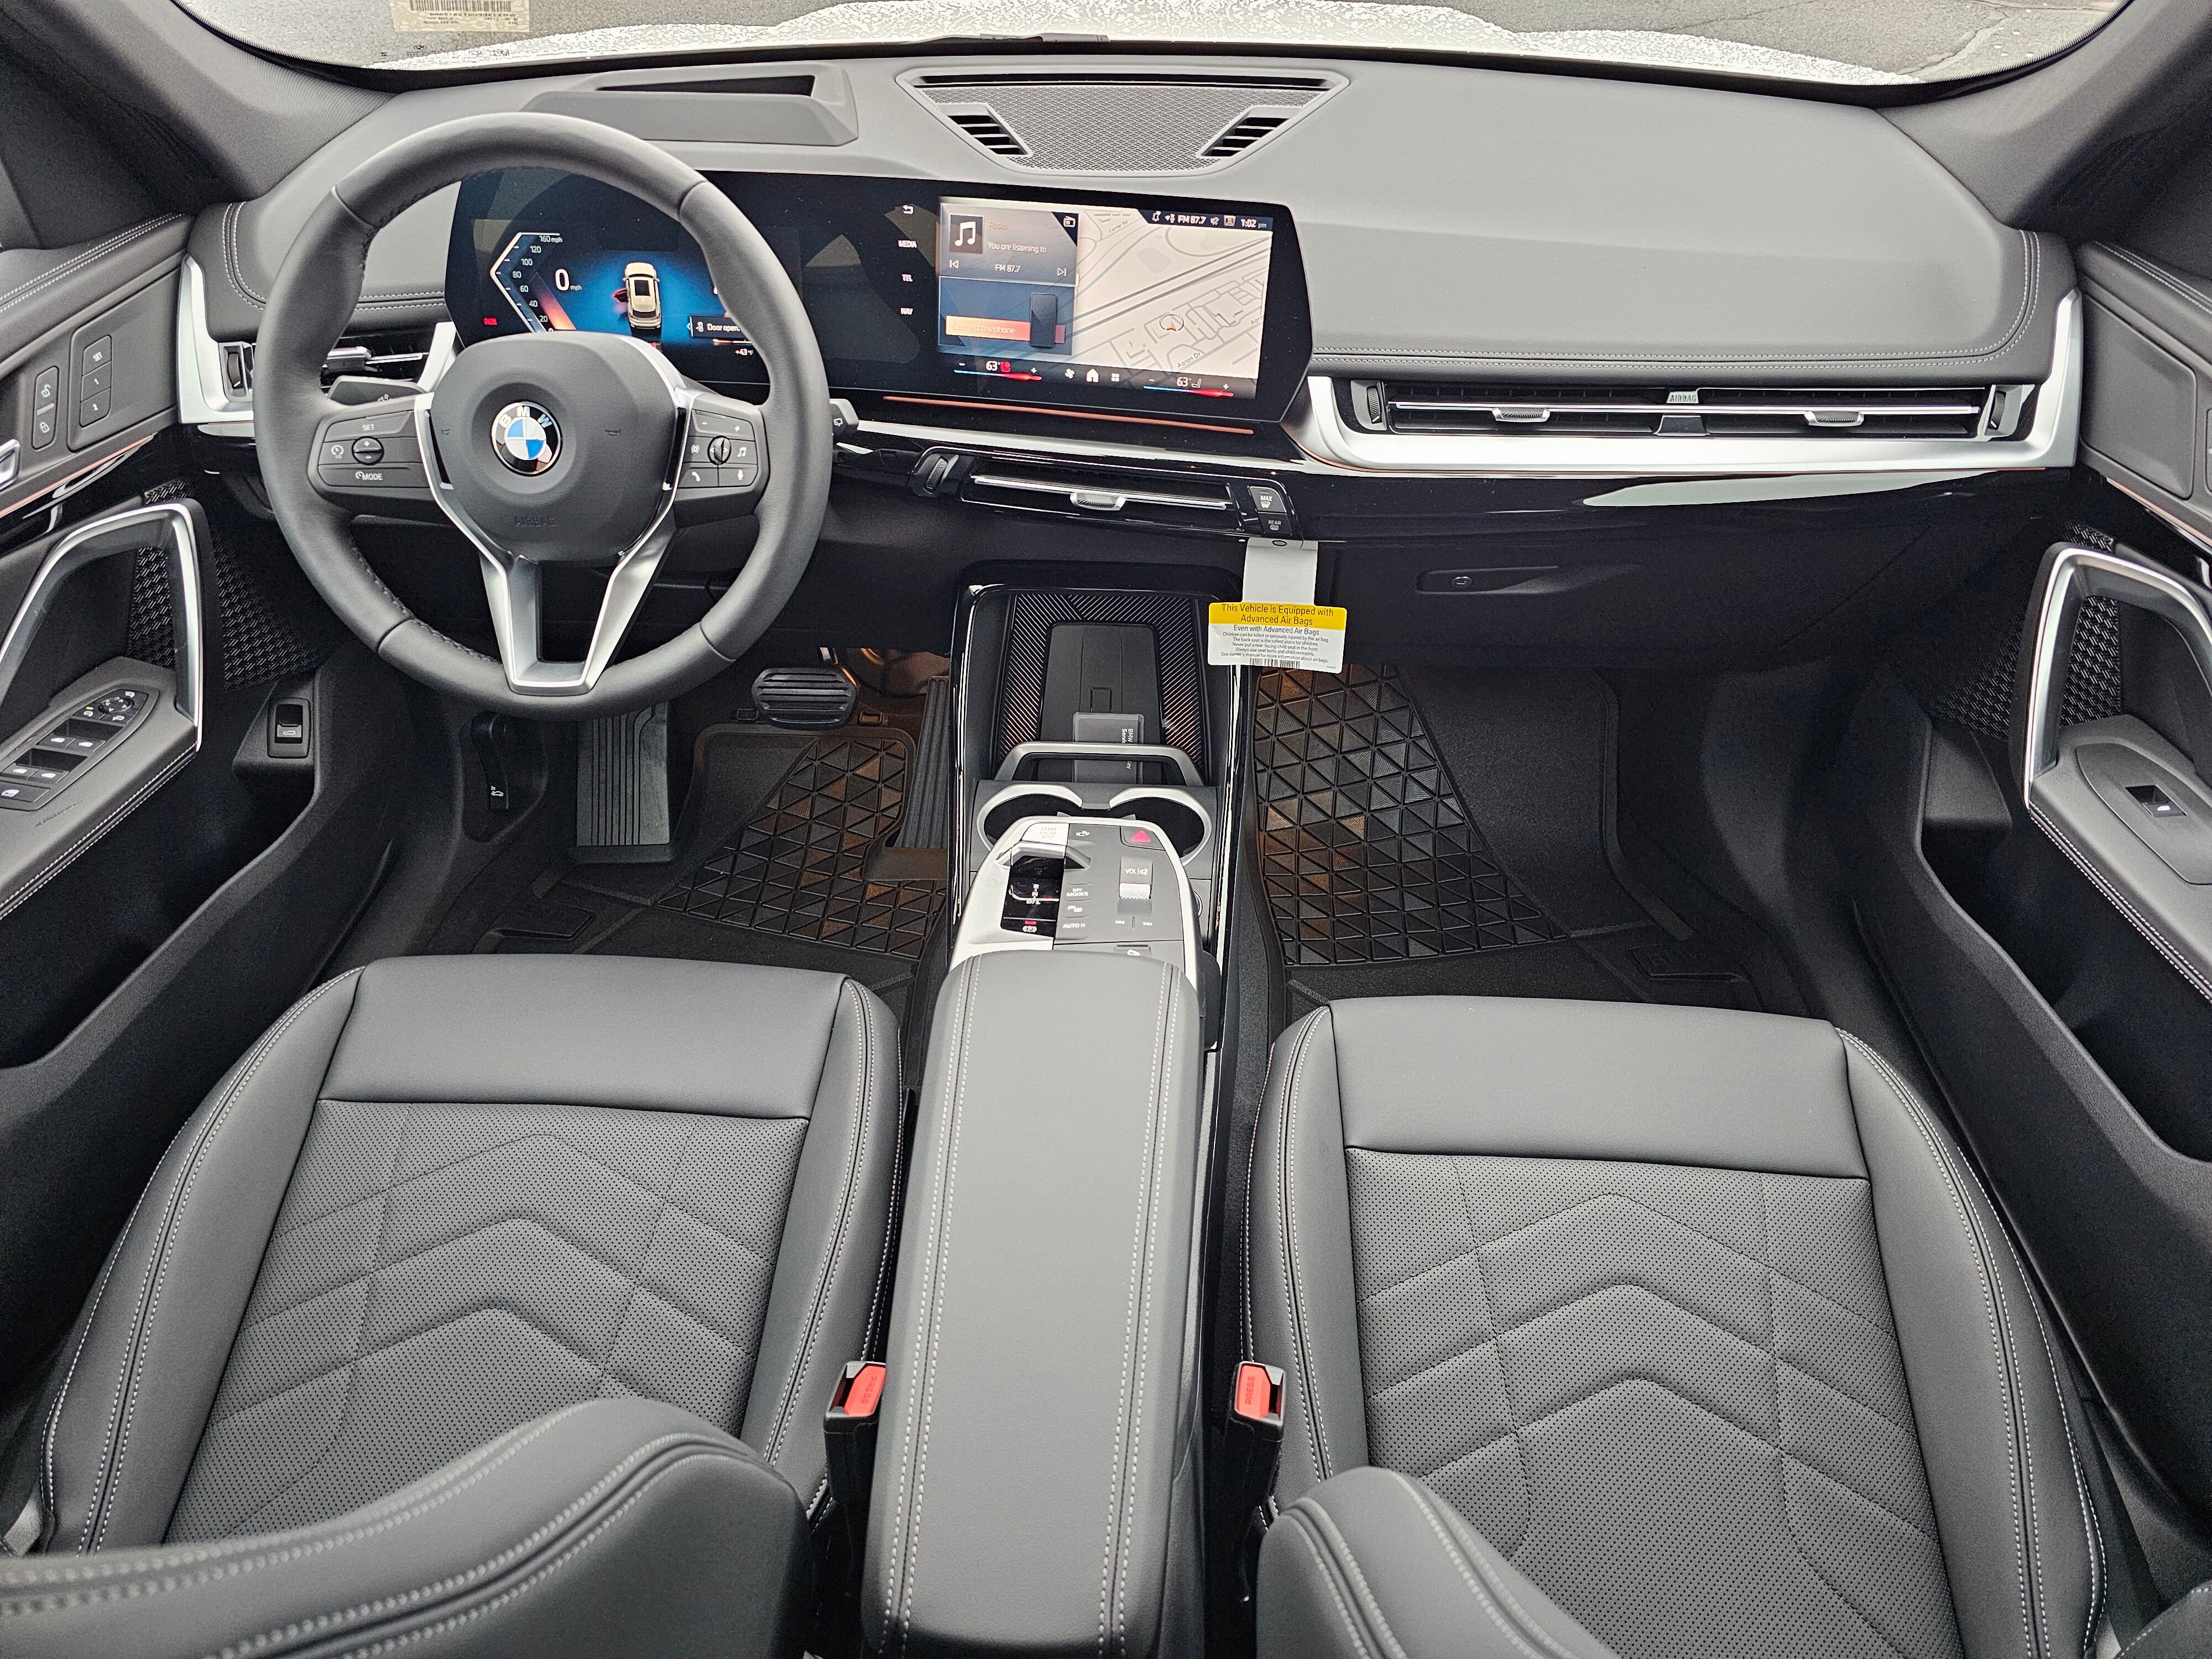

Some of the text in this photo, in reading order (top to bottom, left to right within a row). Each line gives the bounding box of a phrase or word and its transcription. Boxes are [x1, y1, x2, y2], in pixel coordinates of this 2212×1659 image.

[1177, 214, 1207, 225] FM 87.7
[898, 240, 917, 248] MEDIA
[987, 242, 1000, 251] You
[1012, 243, 1040, 254] listening
[1006, 265, 1021, 274] 87.7
[555, 268, 570, 291] 0
[901, 274, 913, 282] TEL
[707, 323, 723, 331] Door
[982, 324, 1016, 335] telephone
[93, 351, 103, 361] SET
[1177, 356, 1194, 368] Aaron
[1670, 394, 1696, 403] AIRBAG
[499, 405, 552, 429] BMW
[1240, 604, 1268, 613] Vehicle
[1270, 605, 1276, 613] is
[1279, 605, 1316, 616] Equipped
[1317, 607, 1334, 617] with
[1240, 614, 1313, 627] Advanced Air Bags
[1263, 625, 1293, 634] Advanced
[1304, 628, 1319, 637] Bags
[861, 1376, 877, 1404] PRESS
[1245, 1375, 1255, 1405] PRESS
